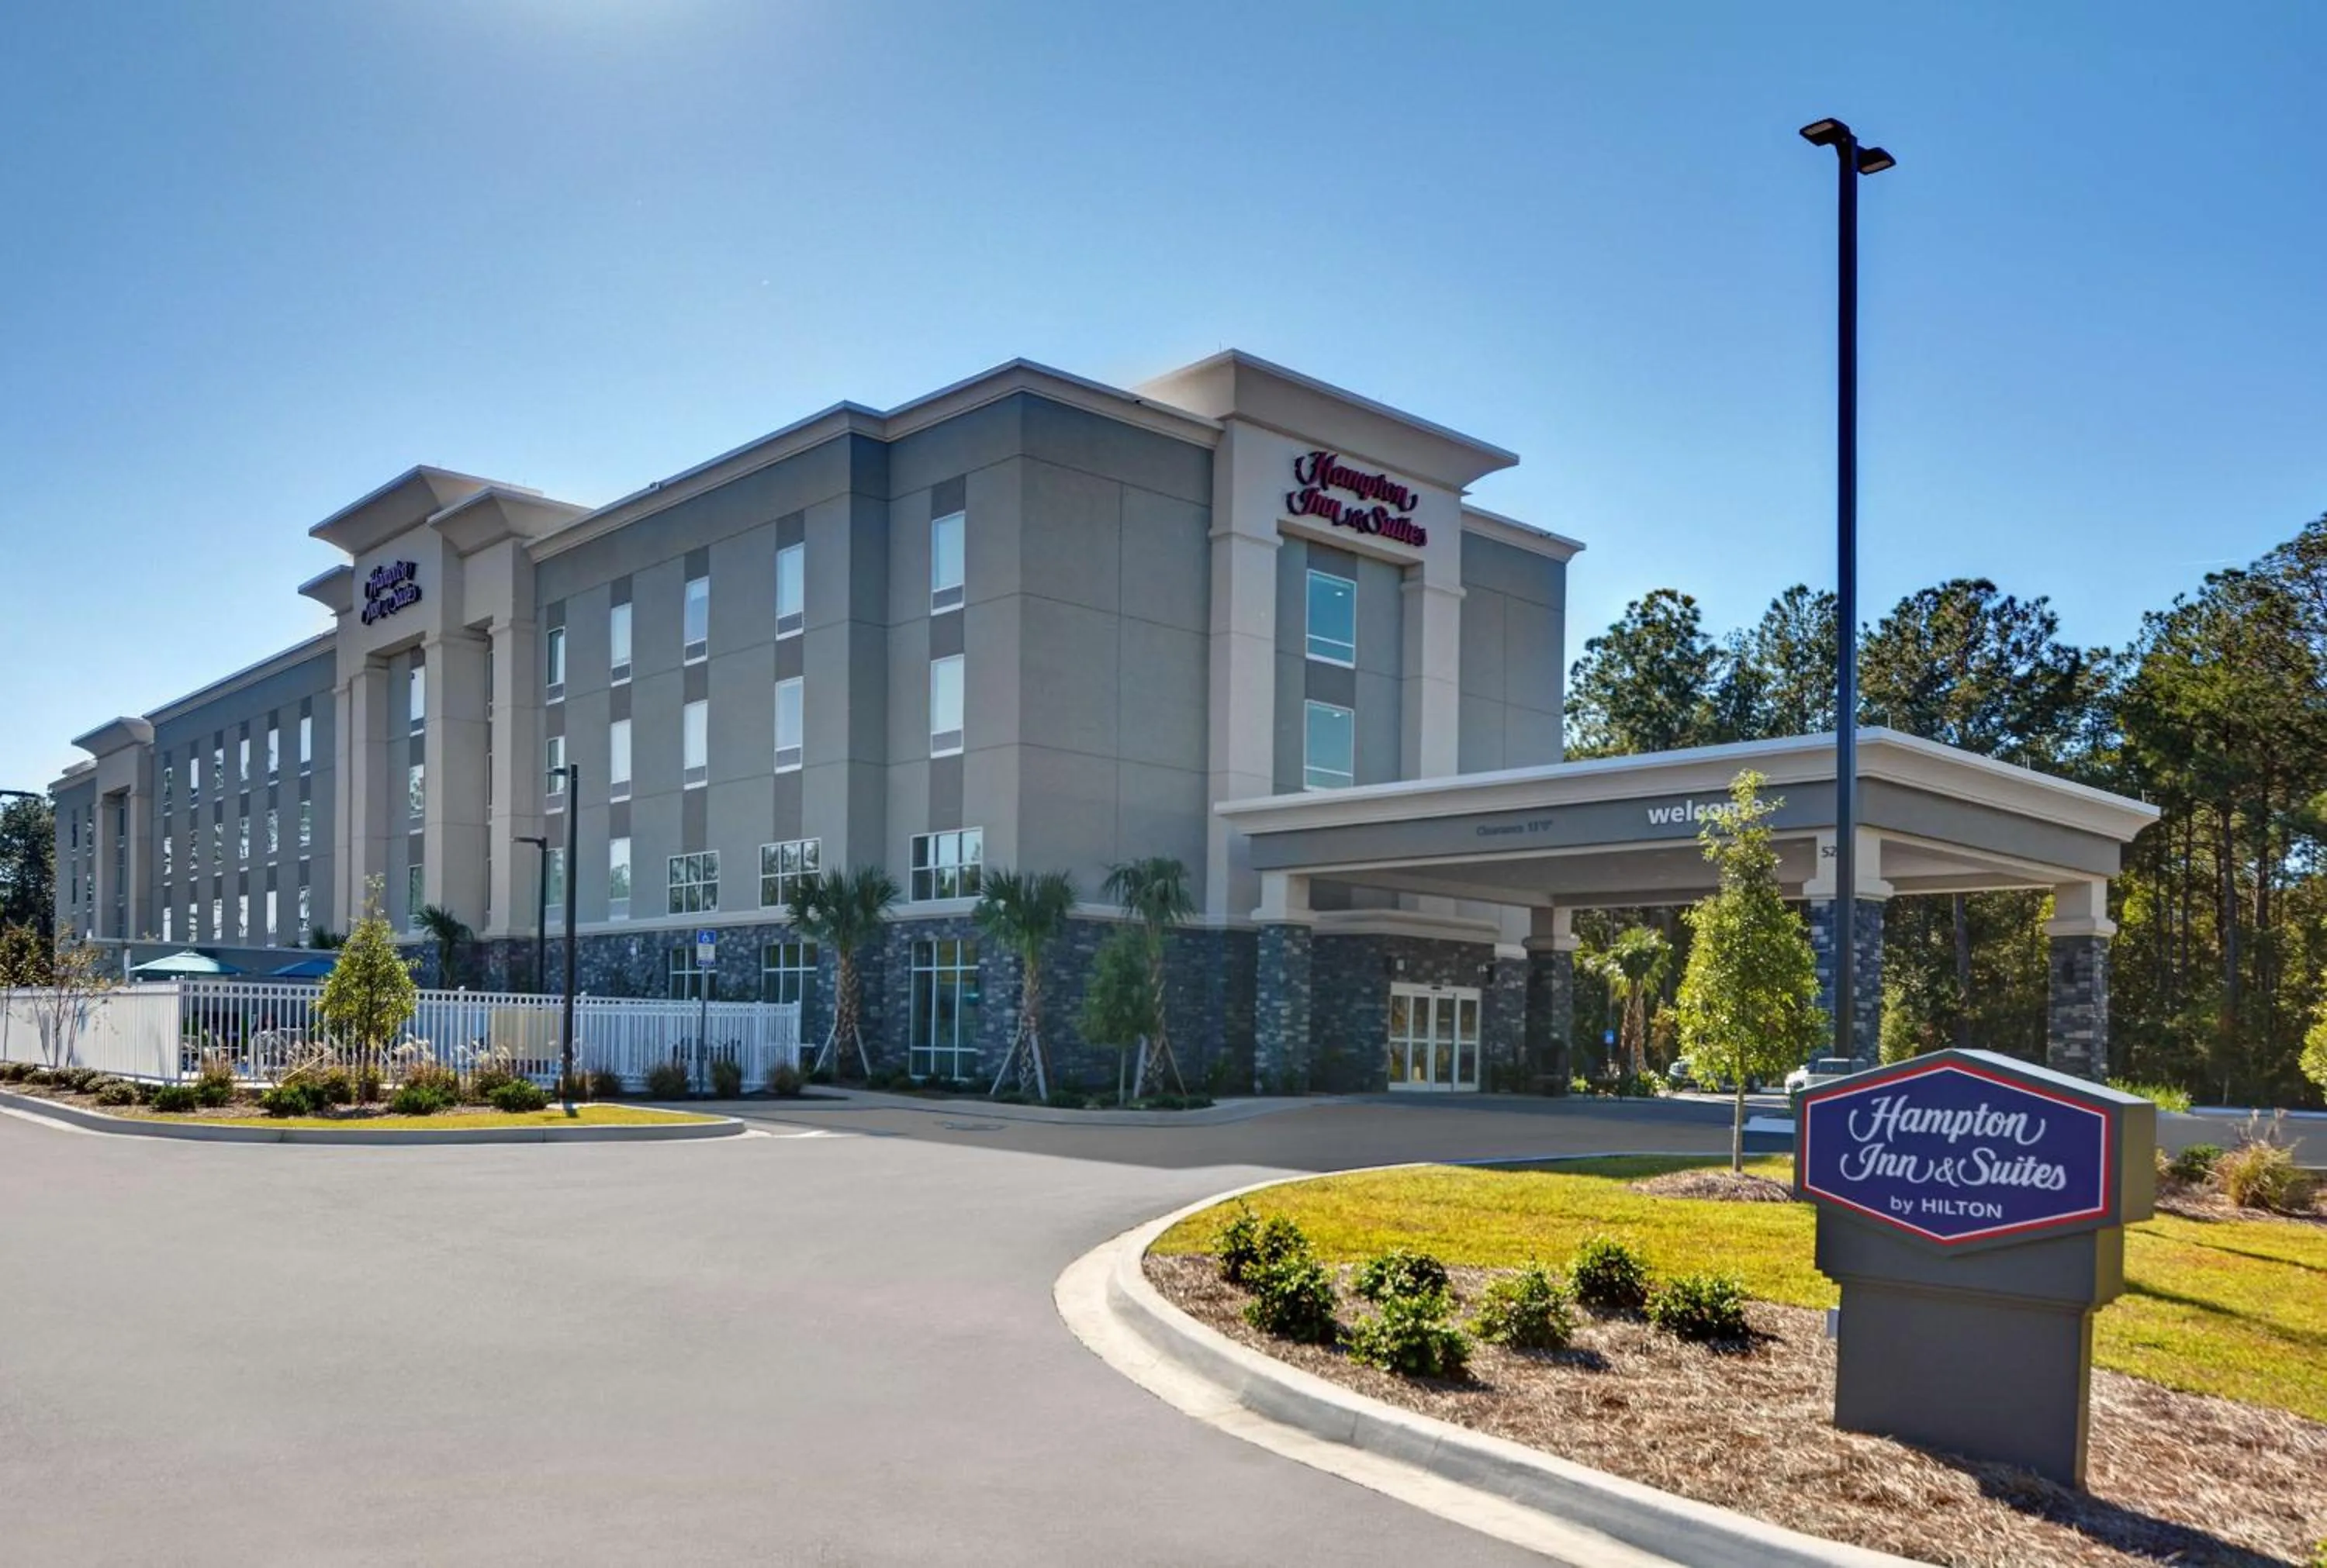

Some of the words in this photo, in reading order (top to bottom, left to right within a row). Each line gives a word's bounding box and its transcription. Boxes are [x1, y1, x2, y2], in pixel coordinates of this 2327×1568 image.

[1294, 451, 1419, 512] Hampton
[1286, 487, 1351, 526] Inn
[1364, 506, 1428, 547] Suites
[1848, 1094, 2046, 1145] Hampton
[1840, 1143, 1935, 1183] Inn
[1934, 1157, 1960, 1188] &
[1957, 1148, 2067, 1191] Suites
[1890, 1196, 1914, 1215] by
[1921, 1198, 2002, 1218] HILTON
